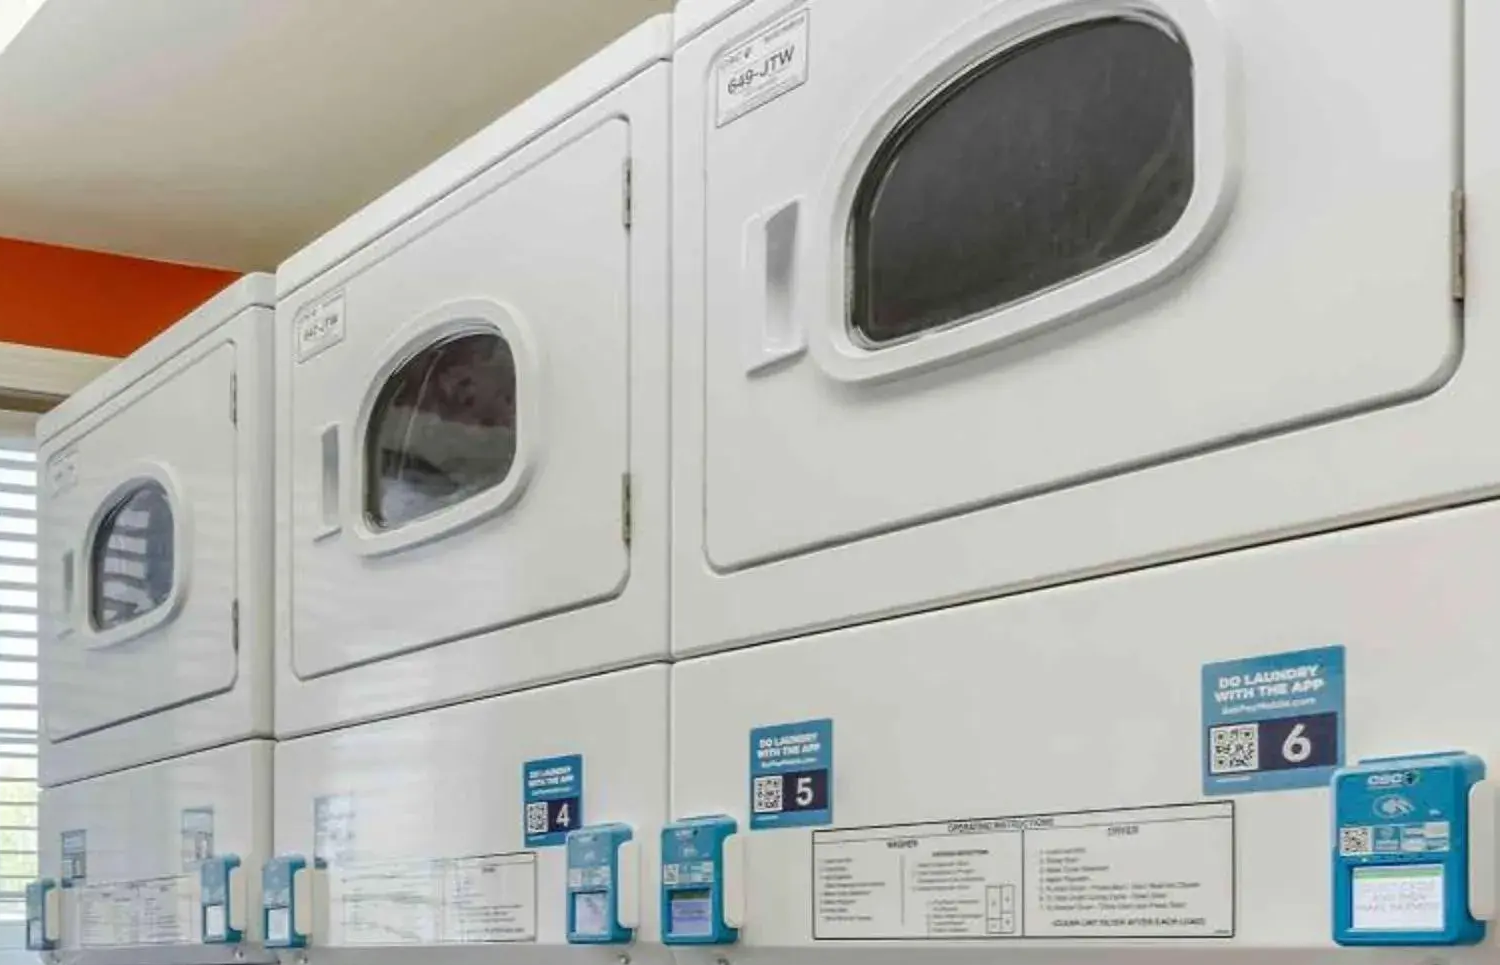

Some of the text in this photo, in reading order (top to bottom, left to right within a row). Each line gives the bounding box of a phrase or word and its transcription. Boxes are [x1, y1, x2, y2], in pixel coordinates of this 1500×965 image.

[727, 43, 795, 95] 649-JTW
[1219, 664, 1320, 689] DO LAUNDRY
[1214, 677, 1324, 703] WITH THE APP
[756, 742, 821, 759] WITH THE APP
[775, 732, 819, 746] LAUNDRY
[1281, 723, 1312, 763] 6
[796, 777, 814, 806] 5
[555, 803, 570, 828] 4
